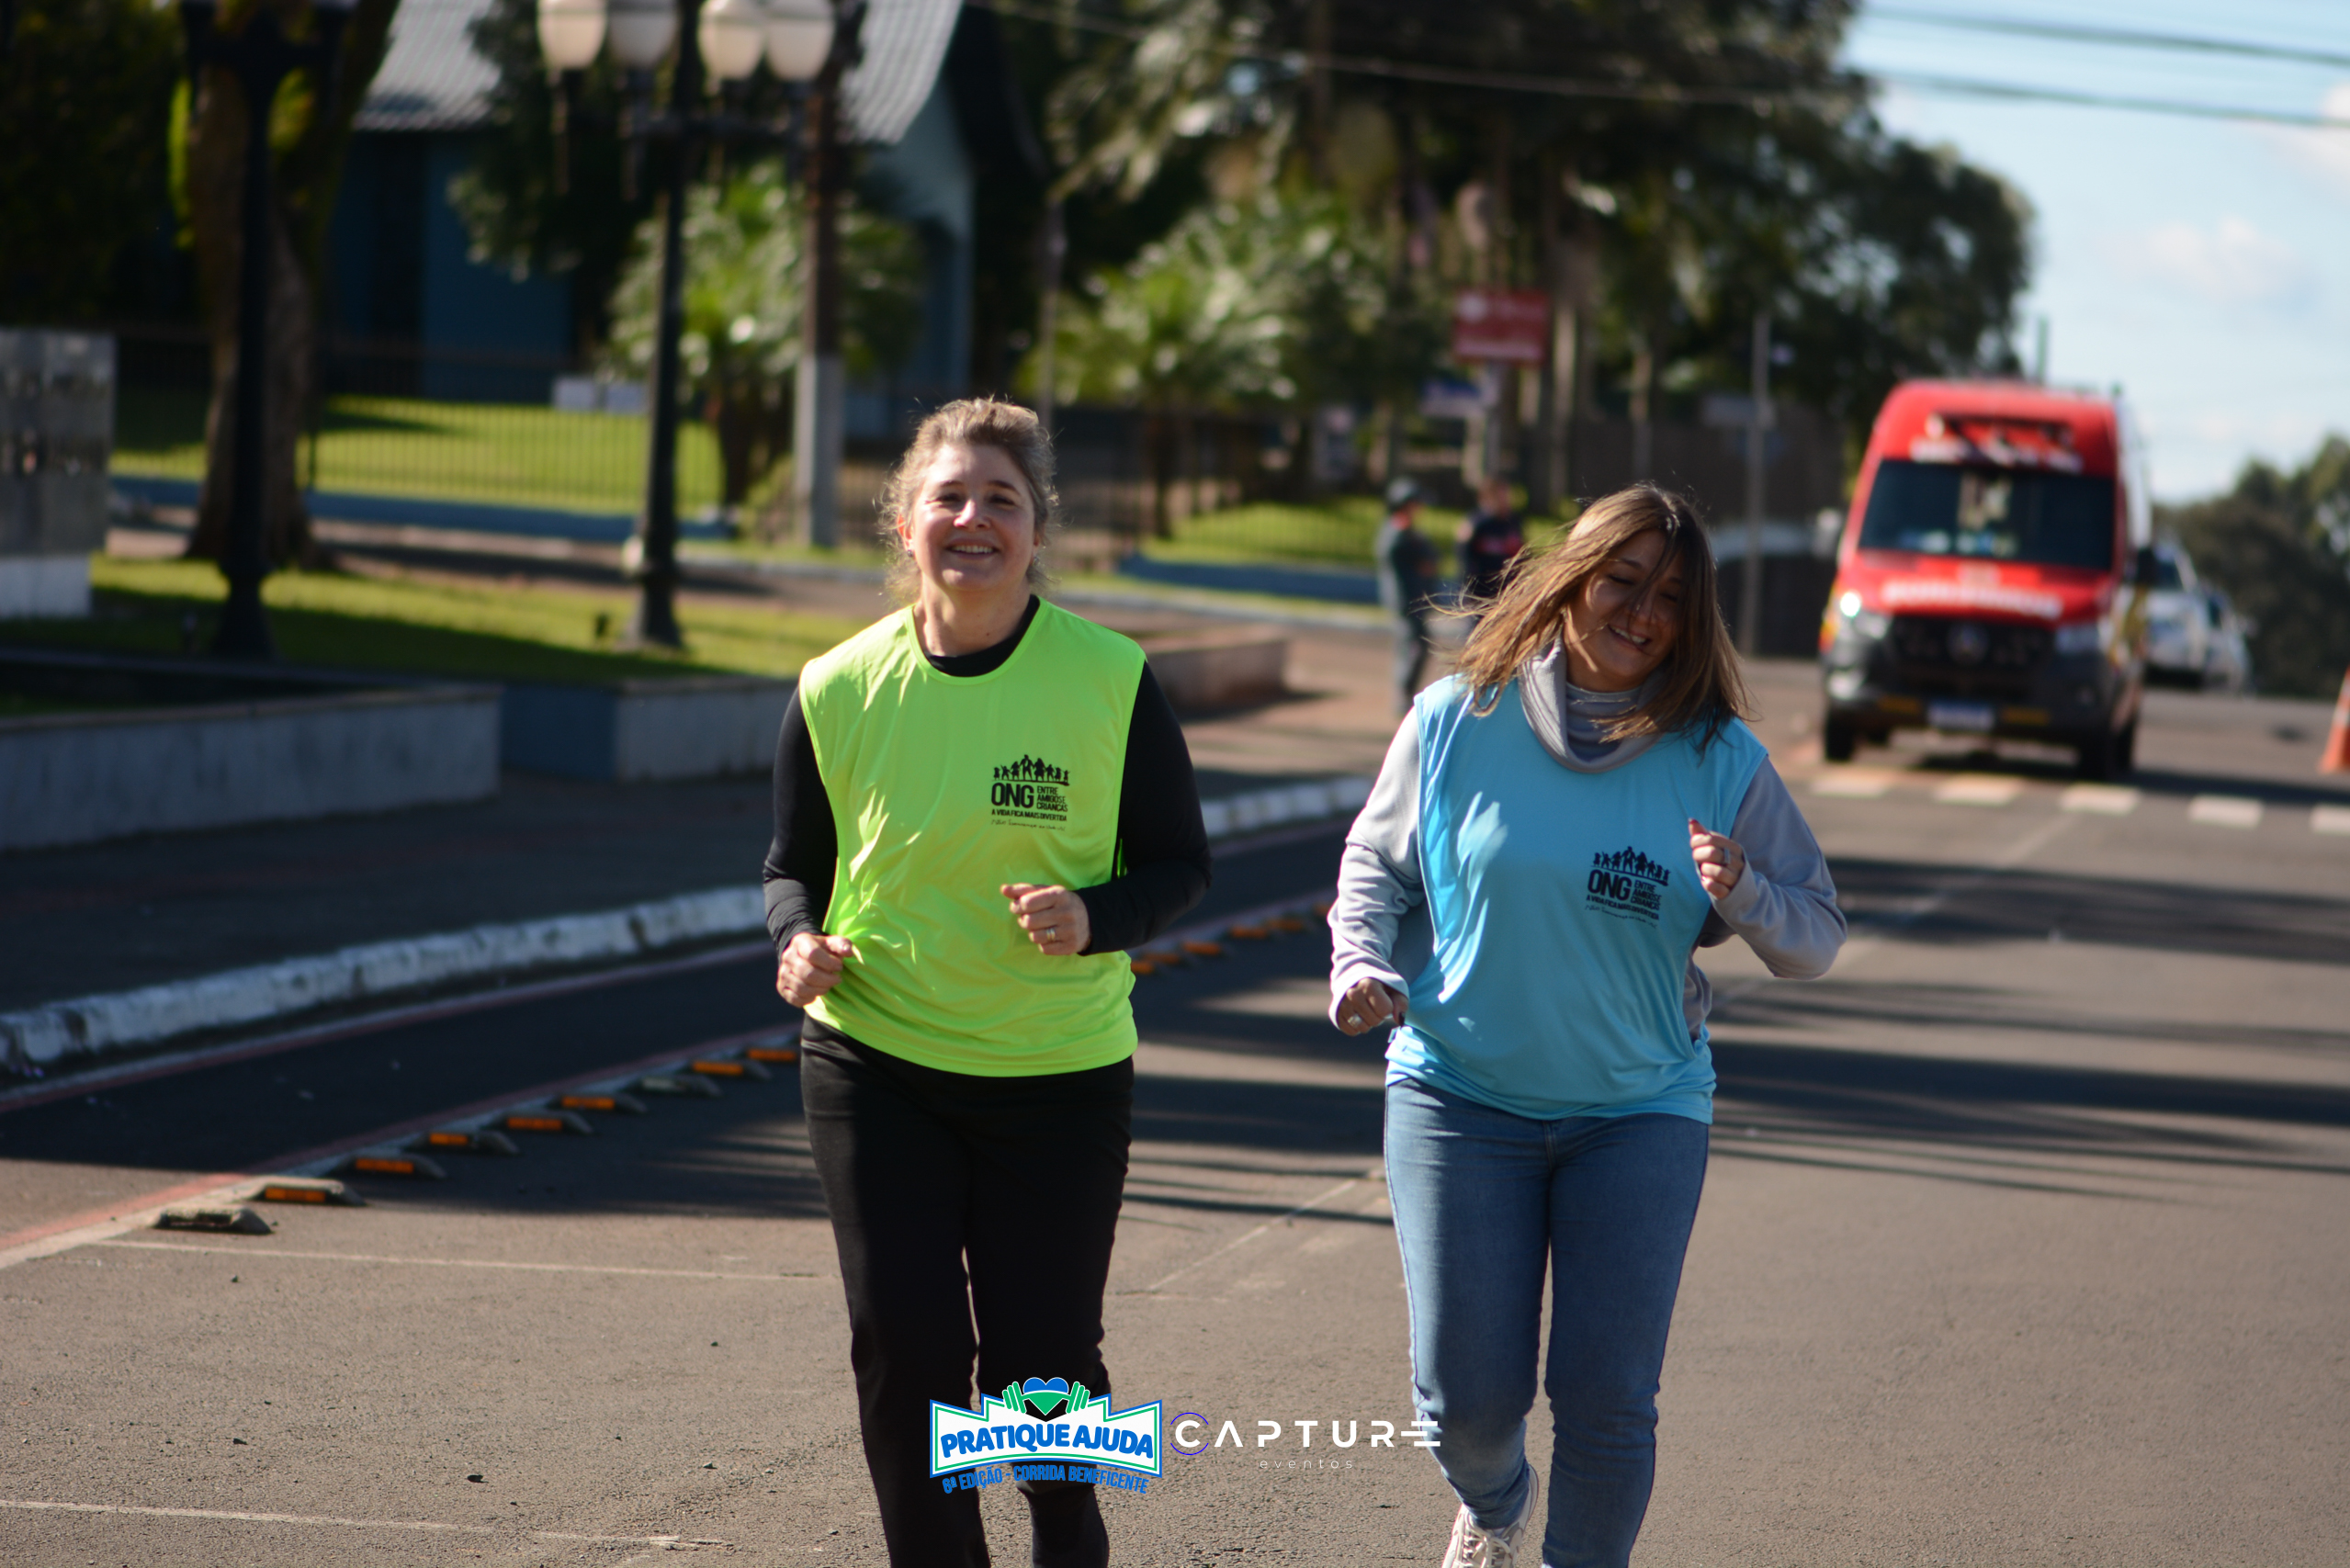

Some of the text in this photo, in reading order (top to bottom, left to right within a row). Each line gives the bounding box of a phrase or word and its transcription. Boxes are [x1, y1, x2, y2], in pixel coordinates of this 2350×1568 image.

[991, 783, 1034, 808] ONG
[1036, 785, 1058, 795] ENTRE
[1024, 811, 1040, 819] MAIS
[1040, 813, 1068, 821] DIVERTIDA
[1587, 869, 1633, 901] ONG
